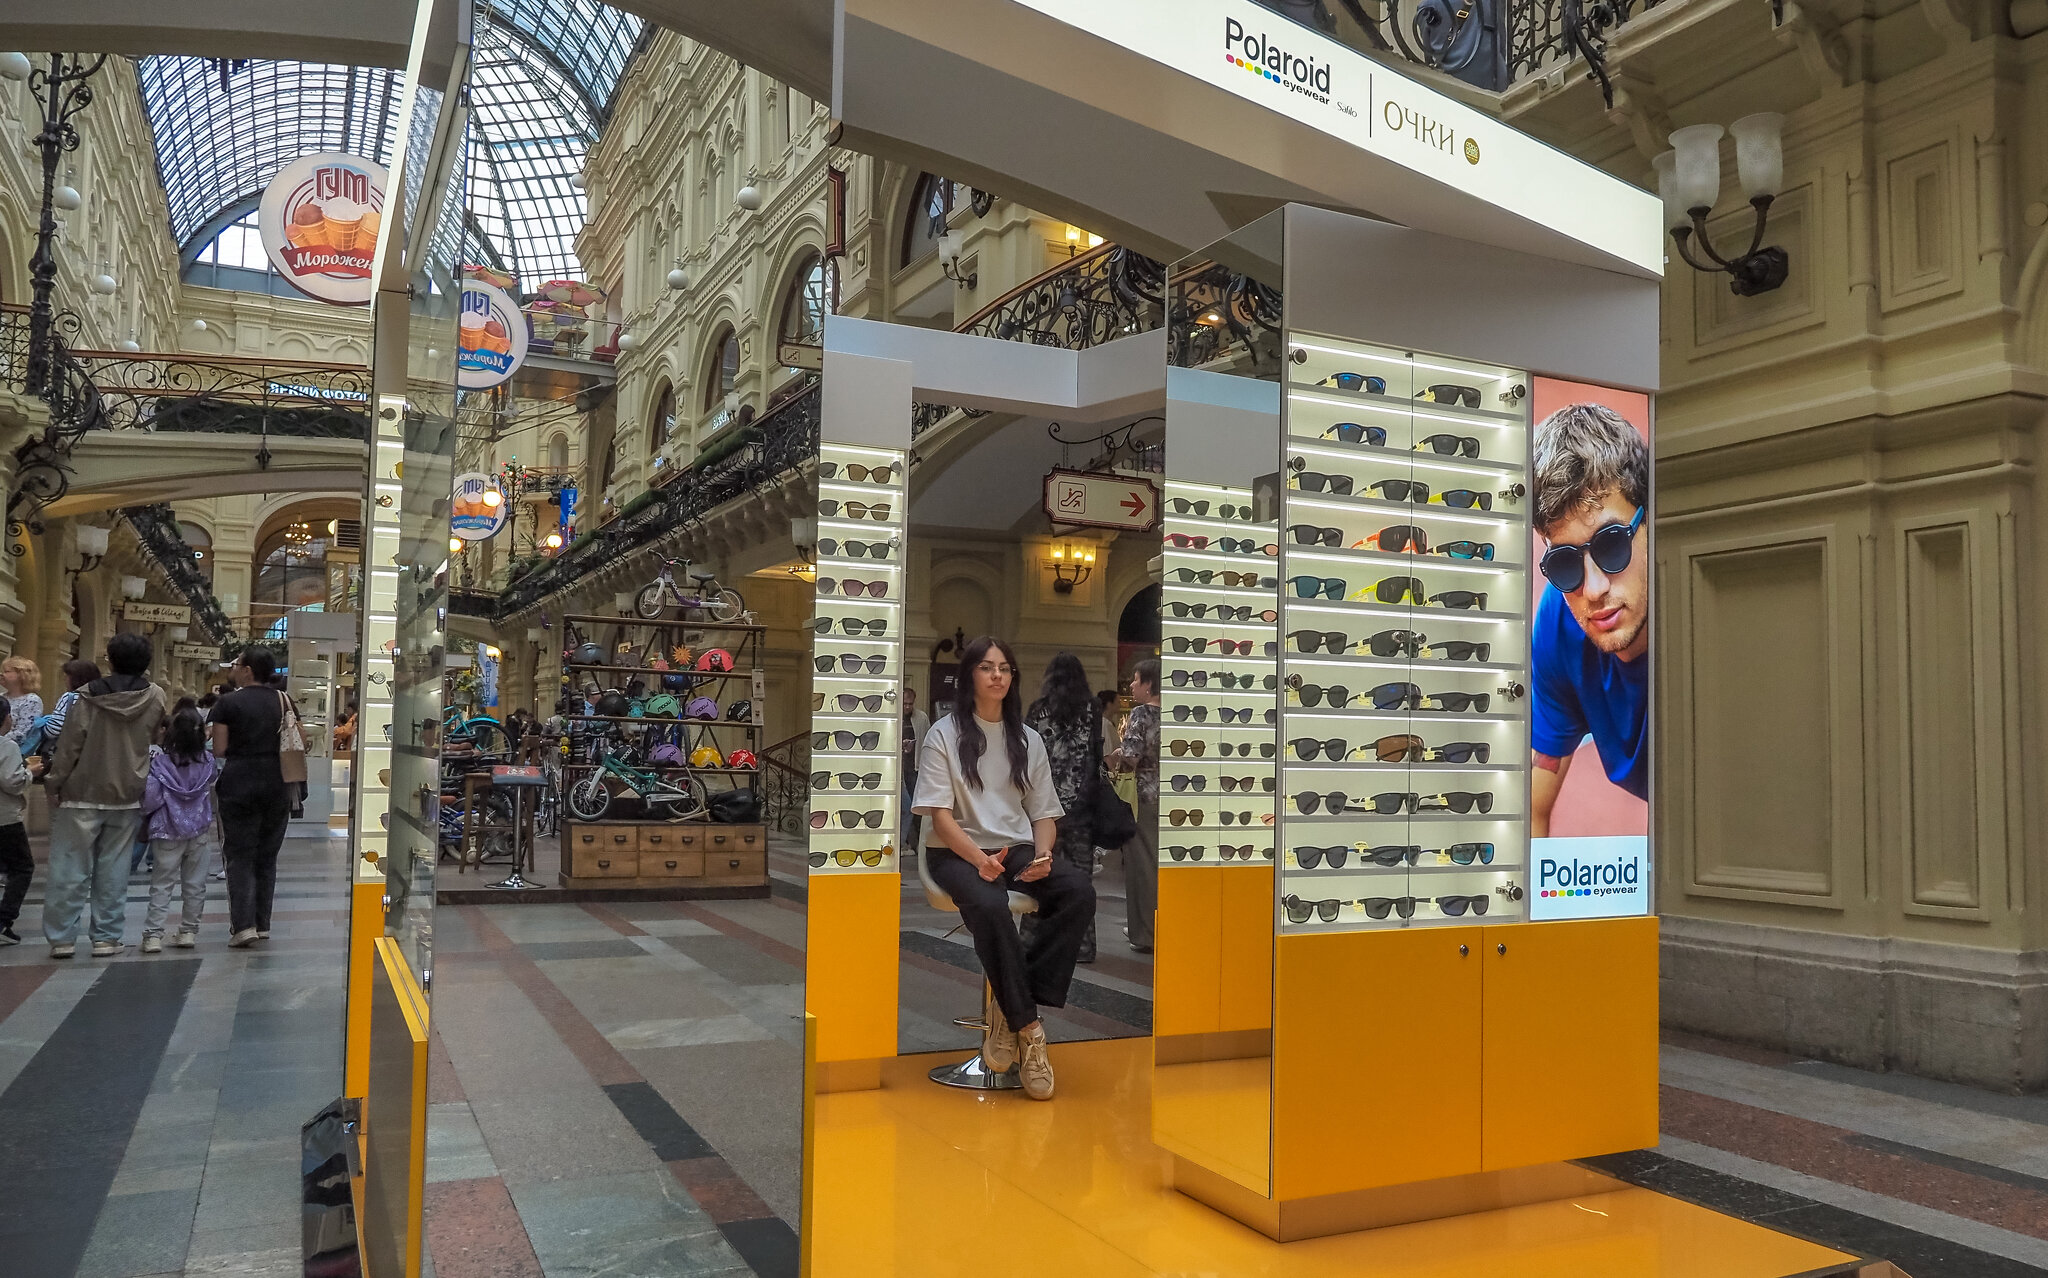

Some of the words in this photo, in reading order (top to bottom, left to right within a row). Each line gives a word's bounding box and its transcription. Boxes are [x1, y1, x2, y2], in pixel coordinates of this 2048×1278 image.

[1226, 17, 1331, 95] Polaroid
[1283, 78, 1330, 105] eyewear
[1384, 101, 1454, 156] ОЧКИ
[316, 168, 369, 205] ГУМ
[1541, 857, 1638, 887] Polaroid
[1593, 886, 1638, 897] eyewear
